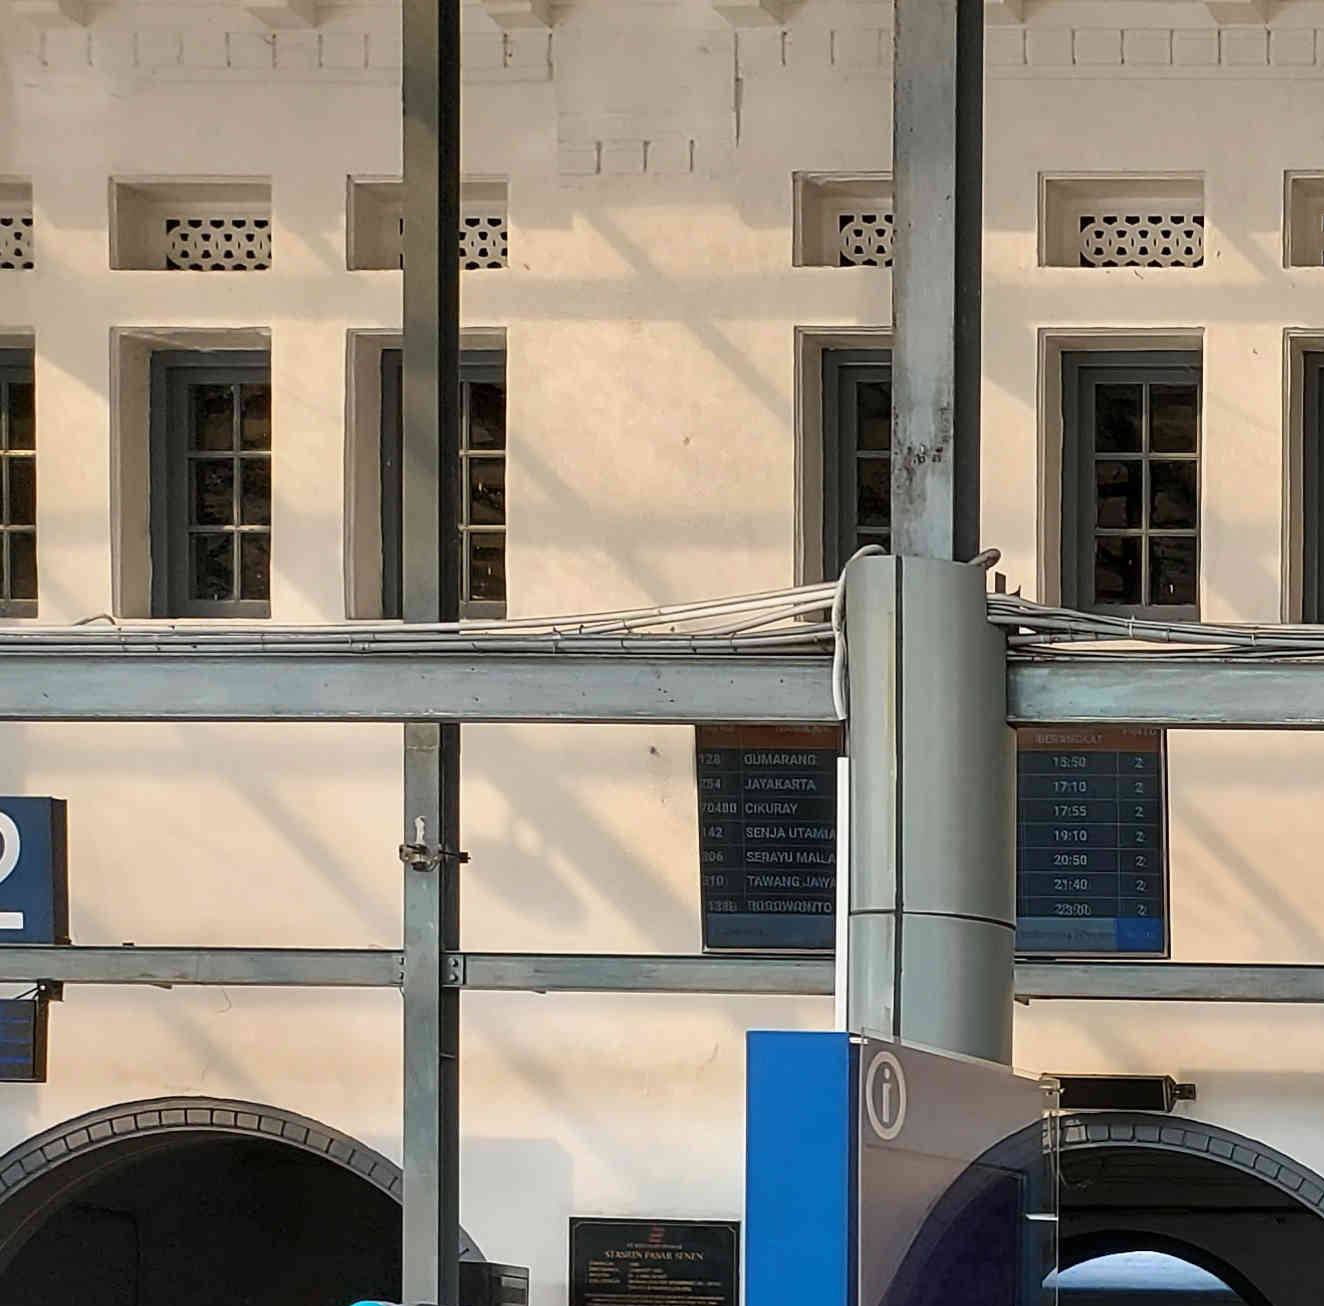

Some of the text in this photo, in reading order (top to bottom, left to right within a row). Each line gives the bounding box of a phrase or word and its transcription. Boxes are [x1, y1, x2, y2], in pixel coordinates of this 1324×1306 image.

[744, 754, 816, 765] GUMARANG
[744, 779, 817, 791] JAYAKARTA
[1054, 781, 1087, 792] 17:10
[745, 802, 799, 814] CIKURAY
[1054, 806, 1087, 816] 17:55
[1136, 806, 1144, 817] 2
[745, 827, 786, 839] SENJA
[1054, 830, 1087, 841] 19:10
[746, 851, 793, 863] SERAYU
[1054, 854, 1087, 865] 20:50
[747, 876, 801, 888] TAWANG
[1054, 879, 1088, 890] 21:40
